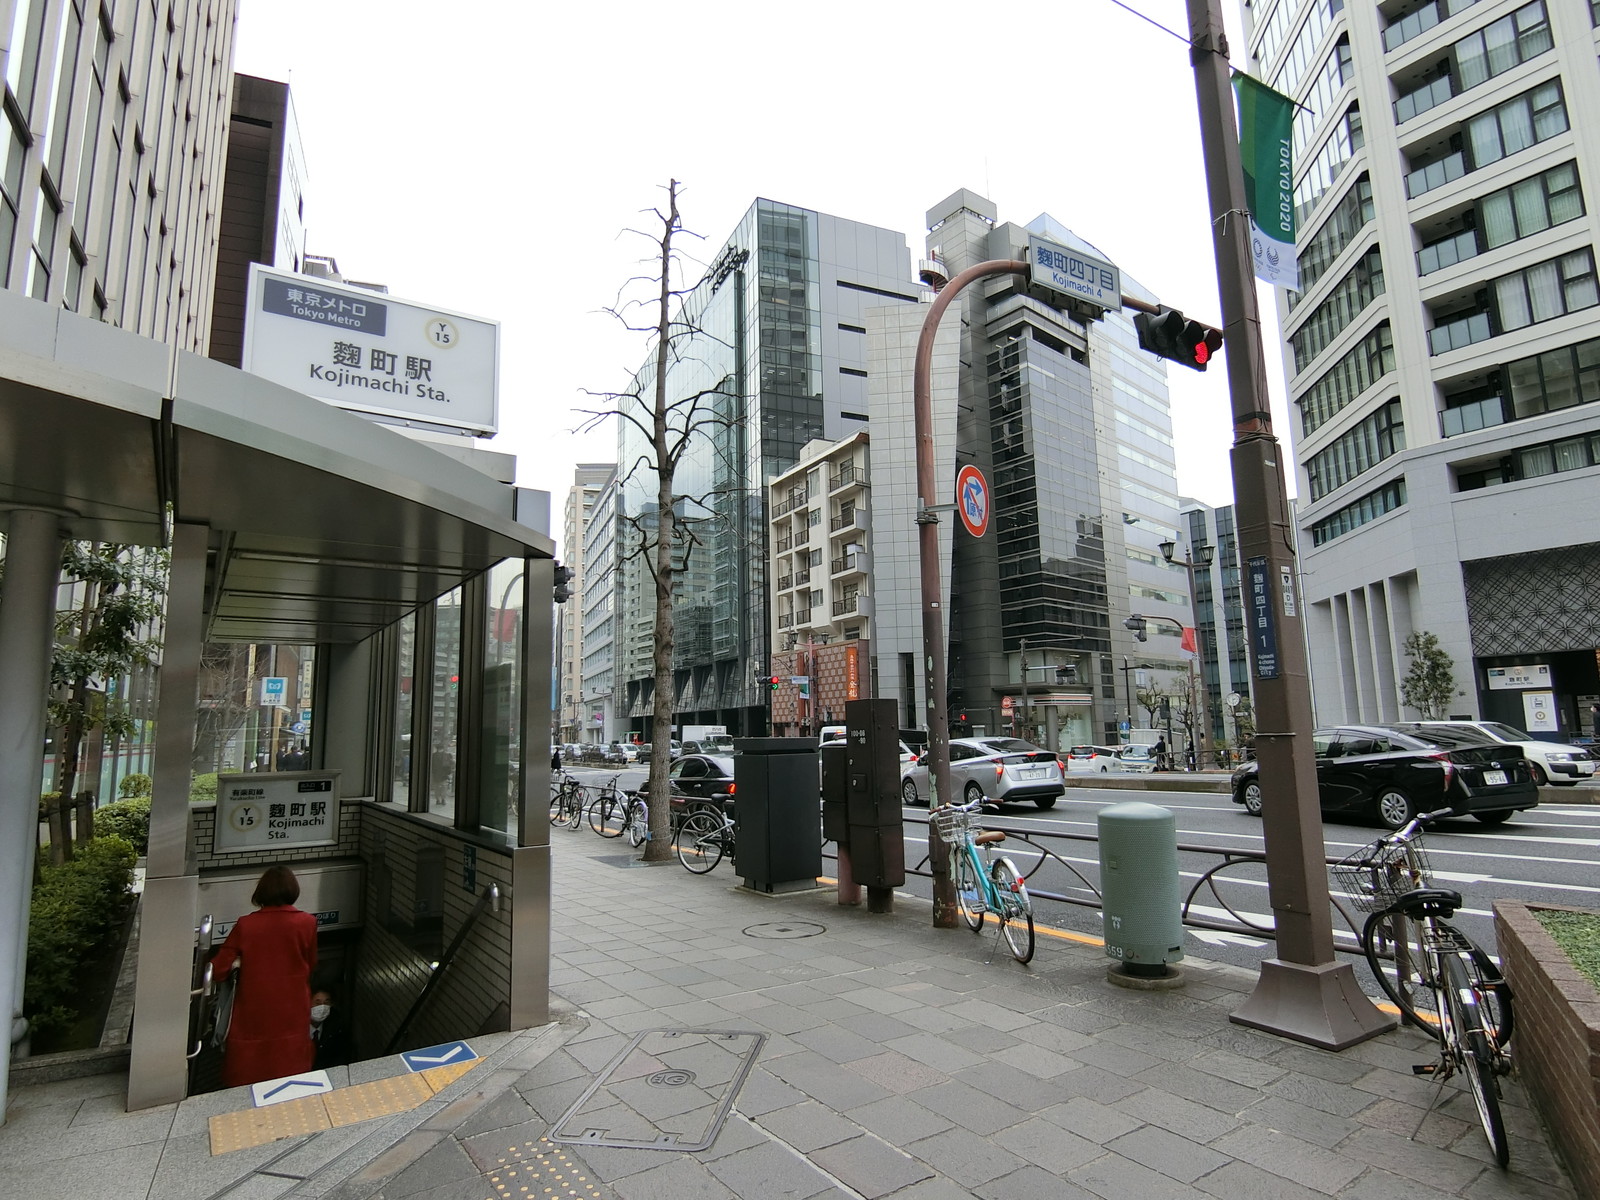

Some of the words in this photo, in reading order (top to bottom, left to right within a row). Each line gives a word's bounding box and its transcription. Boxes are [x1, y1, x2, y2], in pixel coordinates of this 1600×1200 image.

[1280, 139, 1291, 190] TOKYO
[1280, 192, 1291, 232] 2020
[1052, 272, 1094, 296] Kojimachi
[1096, 288, 1103, 298] 4
[286, 288, 366, 317] 東京メトロ
[290, 304, 325, 320] Tokyo
[331, 312, 361, 328] Metro
[438, 322, 447, 332] Y
[435, 331, 450, 344] 15
[310, 363, 409, 396] Kojimachi
[416, 384, 451, 403] Sta.
[1260, 635, 1267, 648] 1
[231, 788, 264, 797] 有楽町線
[320, 781, 326, 791] 1
[243, 807, 251, 816] Y
[239, 816, 254, 826] 15
[268, 816, 325, 830] Kojimachi
[268, 831, 290, 840] Sta.
